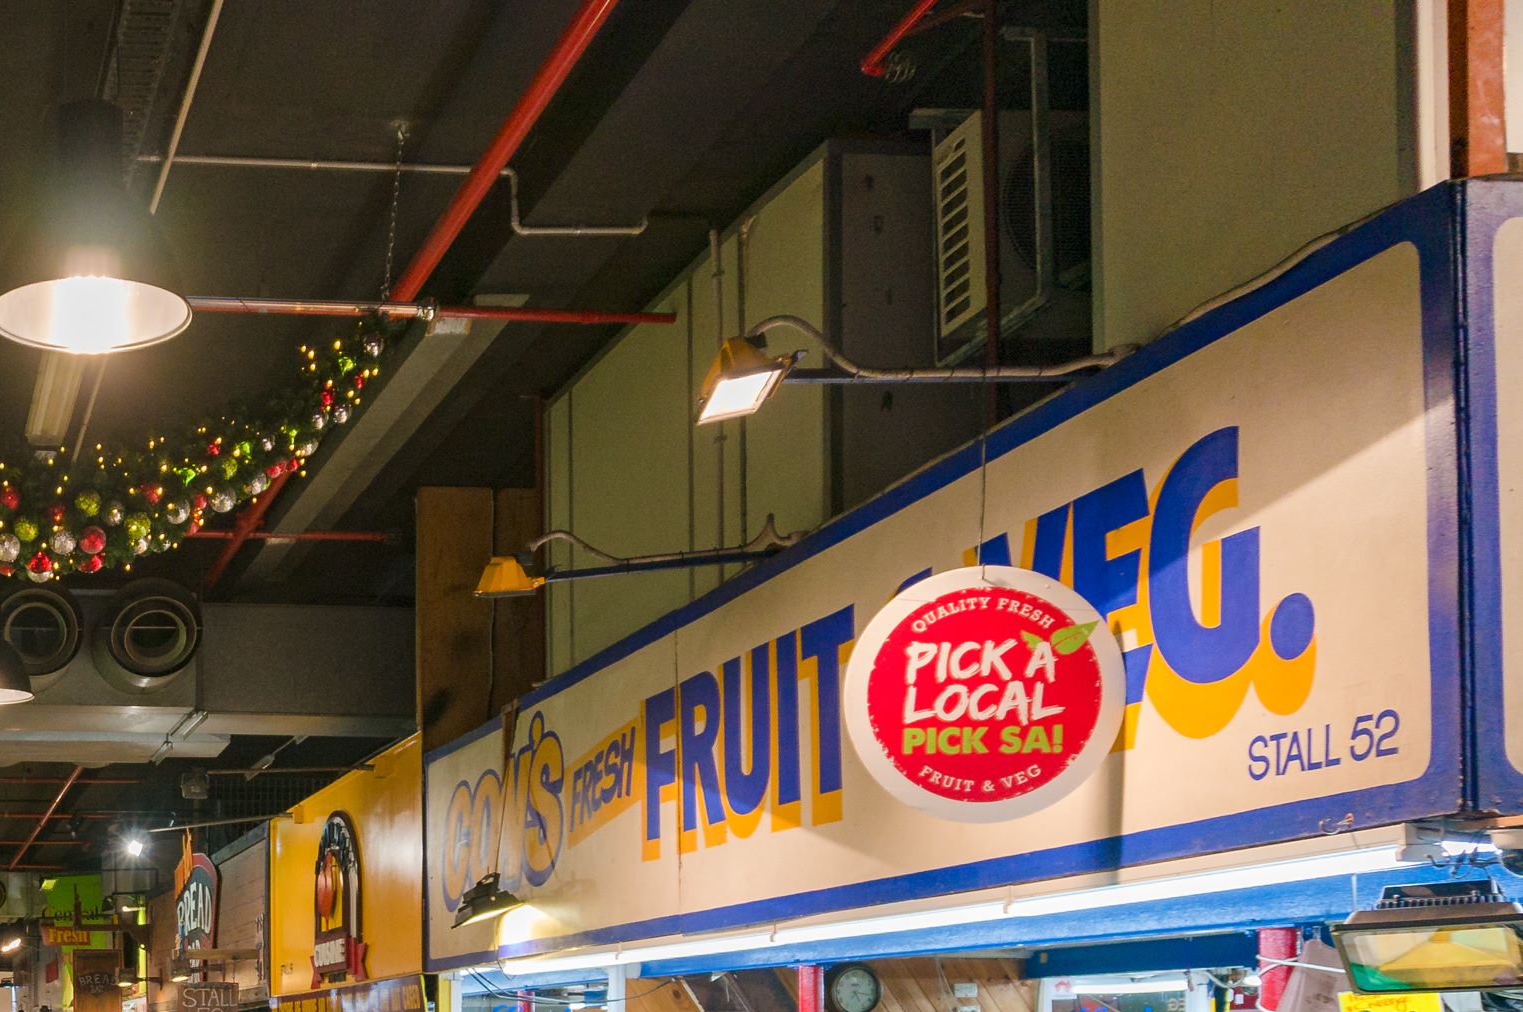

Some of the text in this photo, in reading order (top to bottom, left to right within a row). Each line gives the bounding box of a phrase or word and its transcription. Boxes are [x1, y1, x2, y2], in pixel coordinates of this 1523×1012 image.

[912, 597, 1056, 633] QUALITY FRESH
[905, 639, 1059, 684] PICK A
[903, 681, 1067, 726] LOCAL
[570, 727, 636, 832] FRESH
[642, 604, 855, 855] FRUIT
[902, 724, 1064, 755] PICK SA!
[1248, 710, 1401, 782] STALL 52
[918, 765, 1042, 792] FRUIT & VEG
[182, 987, 238, 1008] STALL
